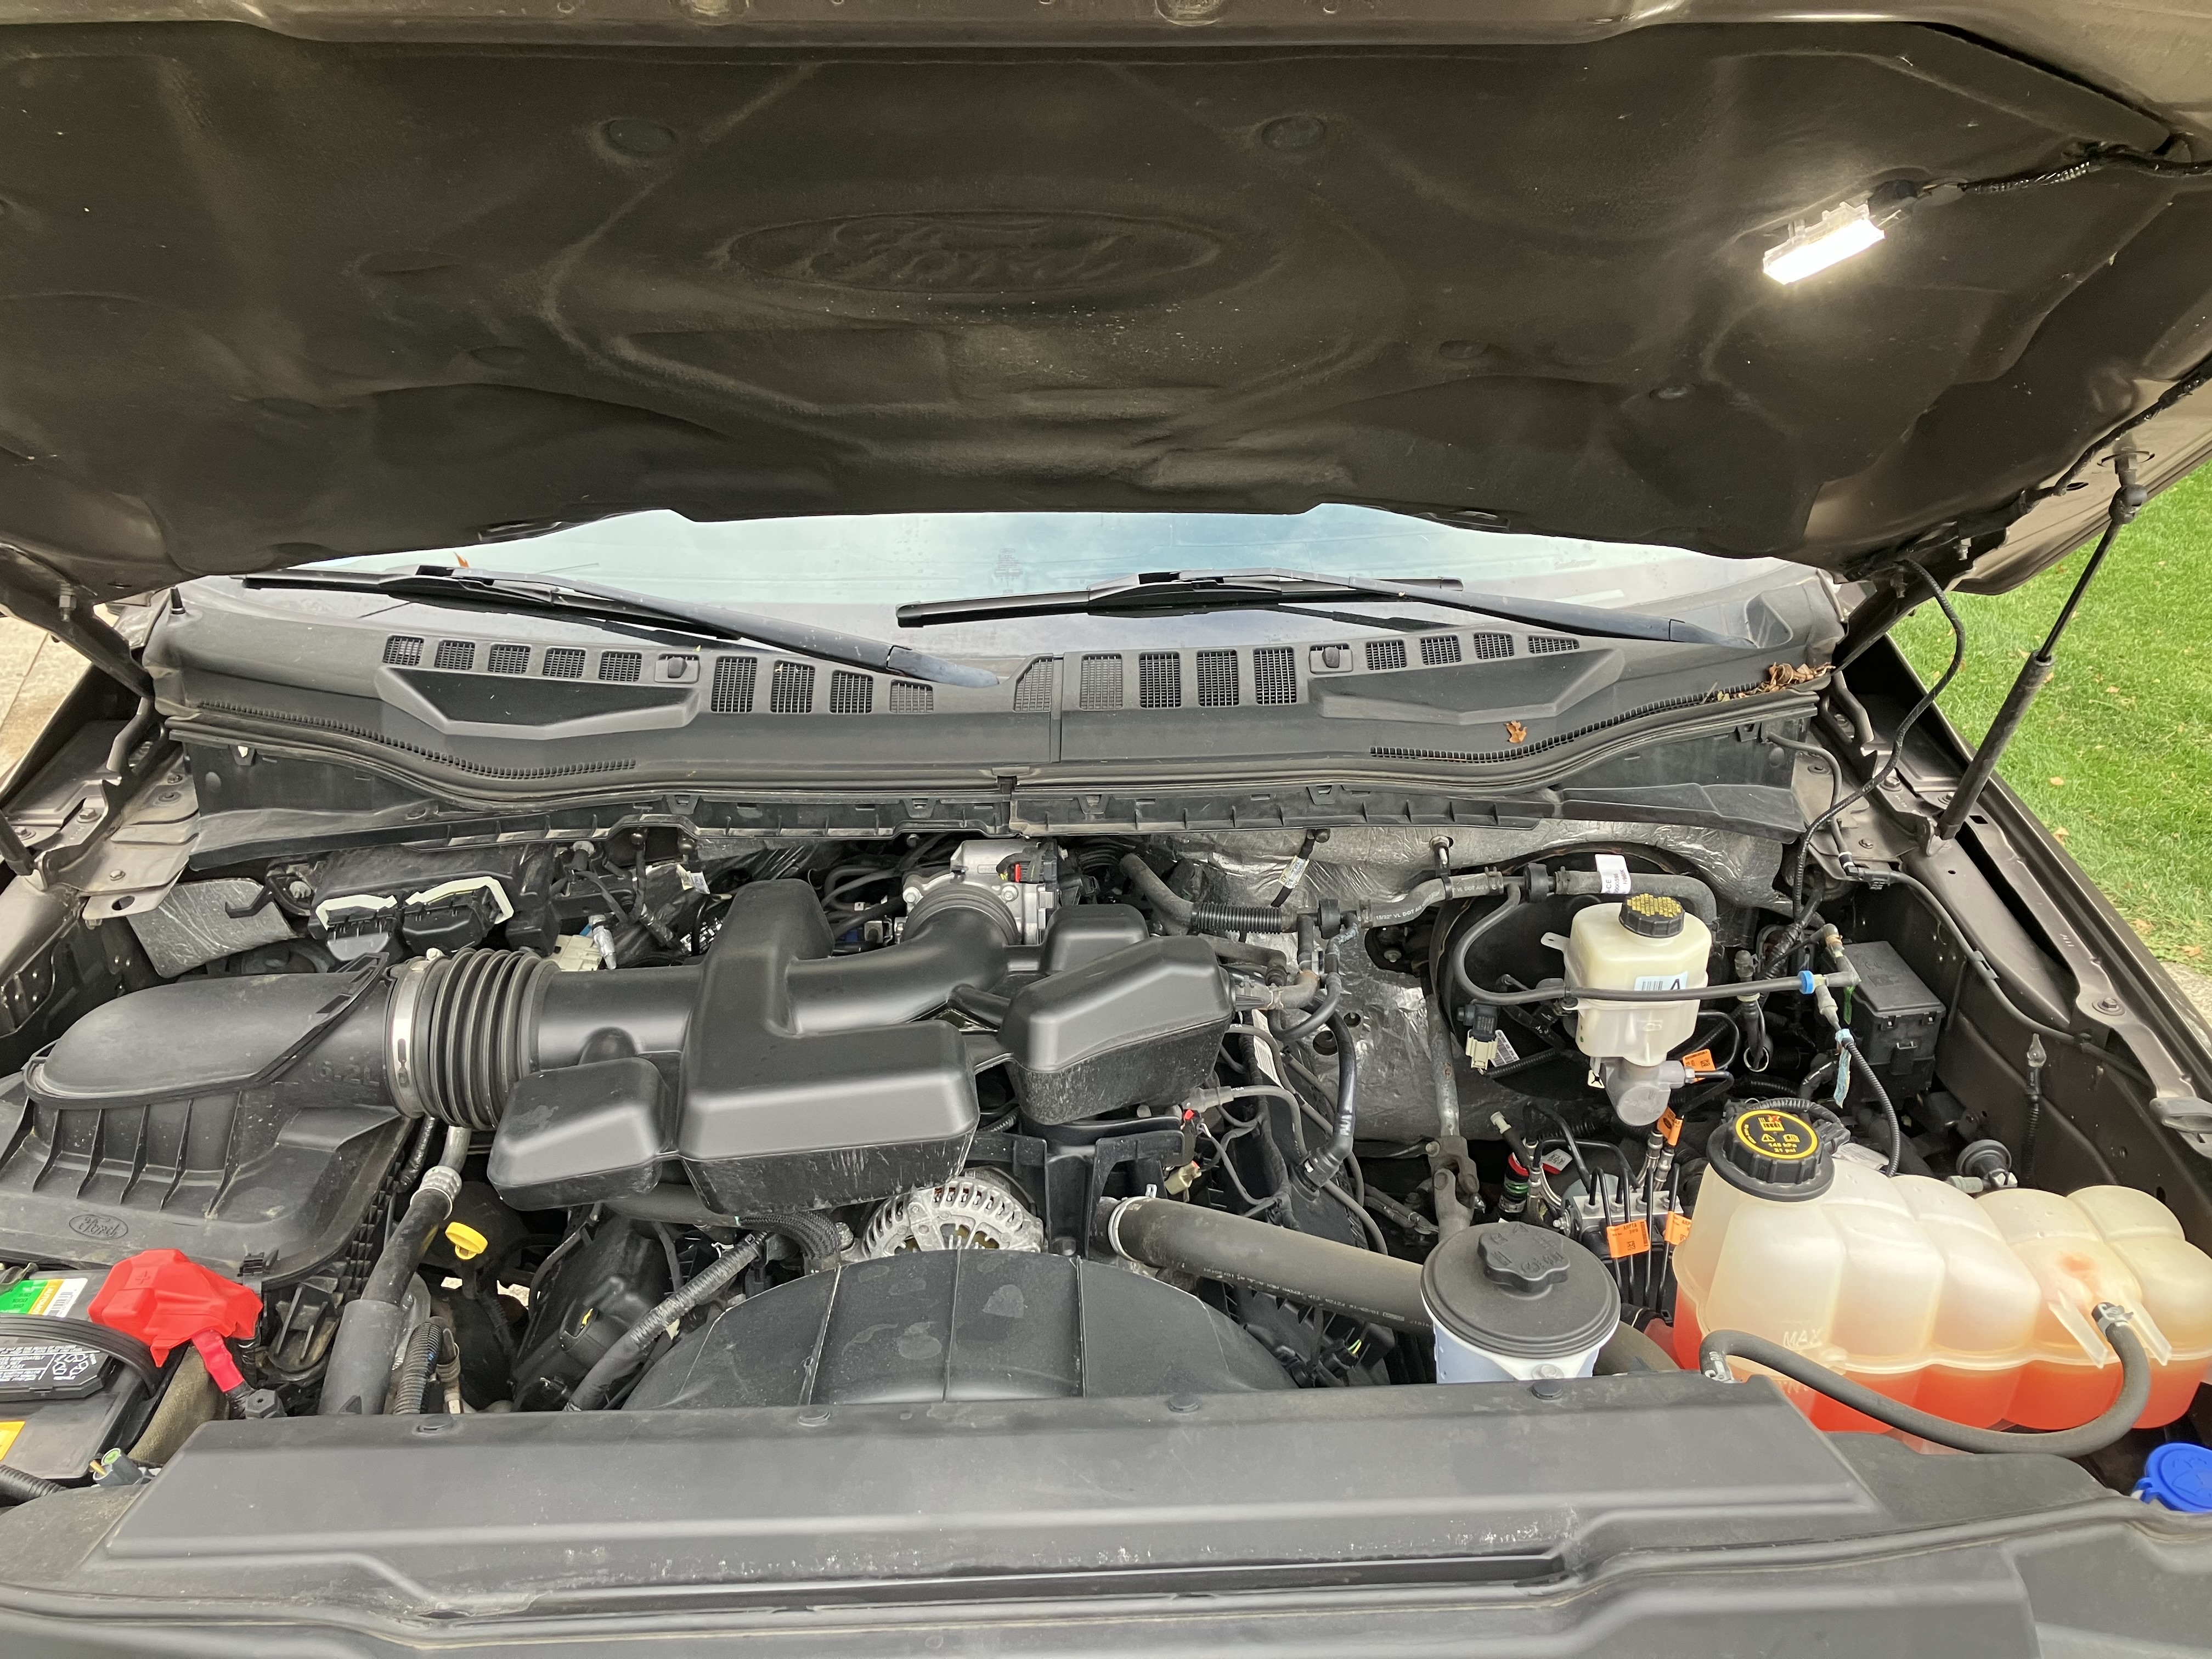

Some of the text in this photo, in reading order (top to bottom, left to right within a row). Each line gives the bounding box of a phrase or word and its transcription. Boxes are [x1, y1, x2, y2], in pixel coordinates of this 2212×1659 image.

[786, 217, 1137, 282] Ford
[314, 1063, 380, 1086] 6.2L
[78, 1216, 120, 1237] Ford
[1783, 1328, 1821, 1347] MAX
